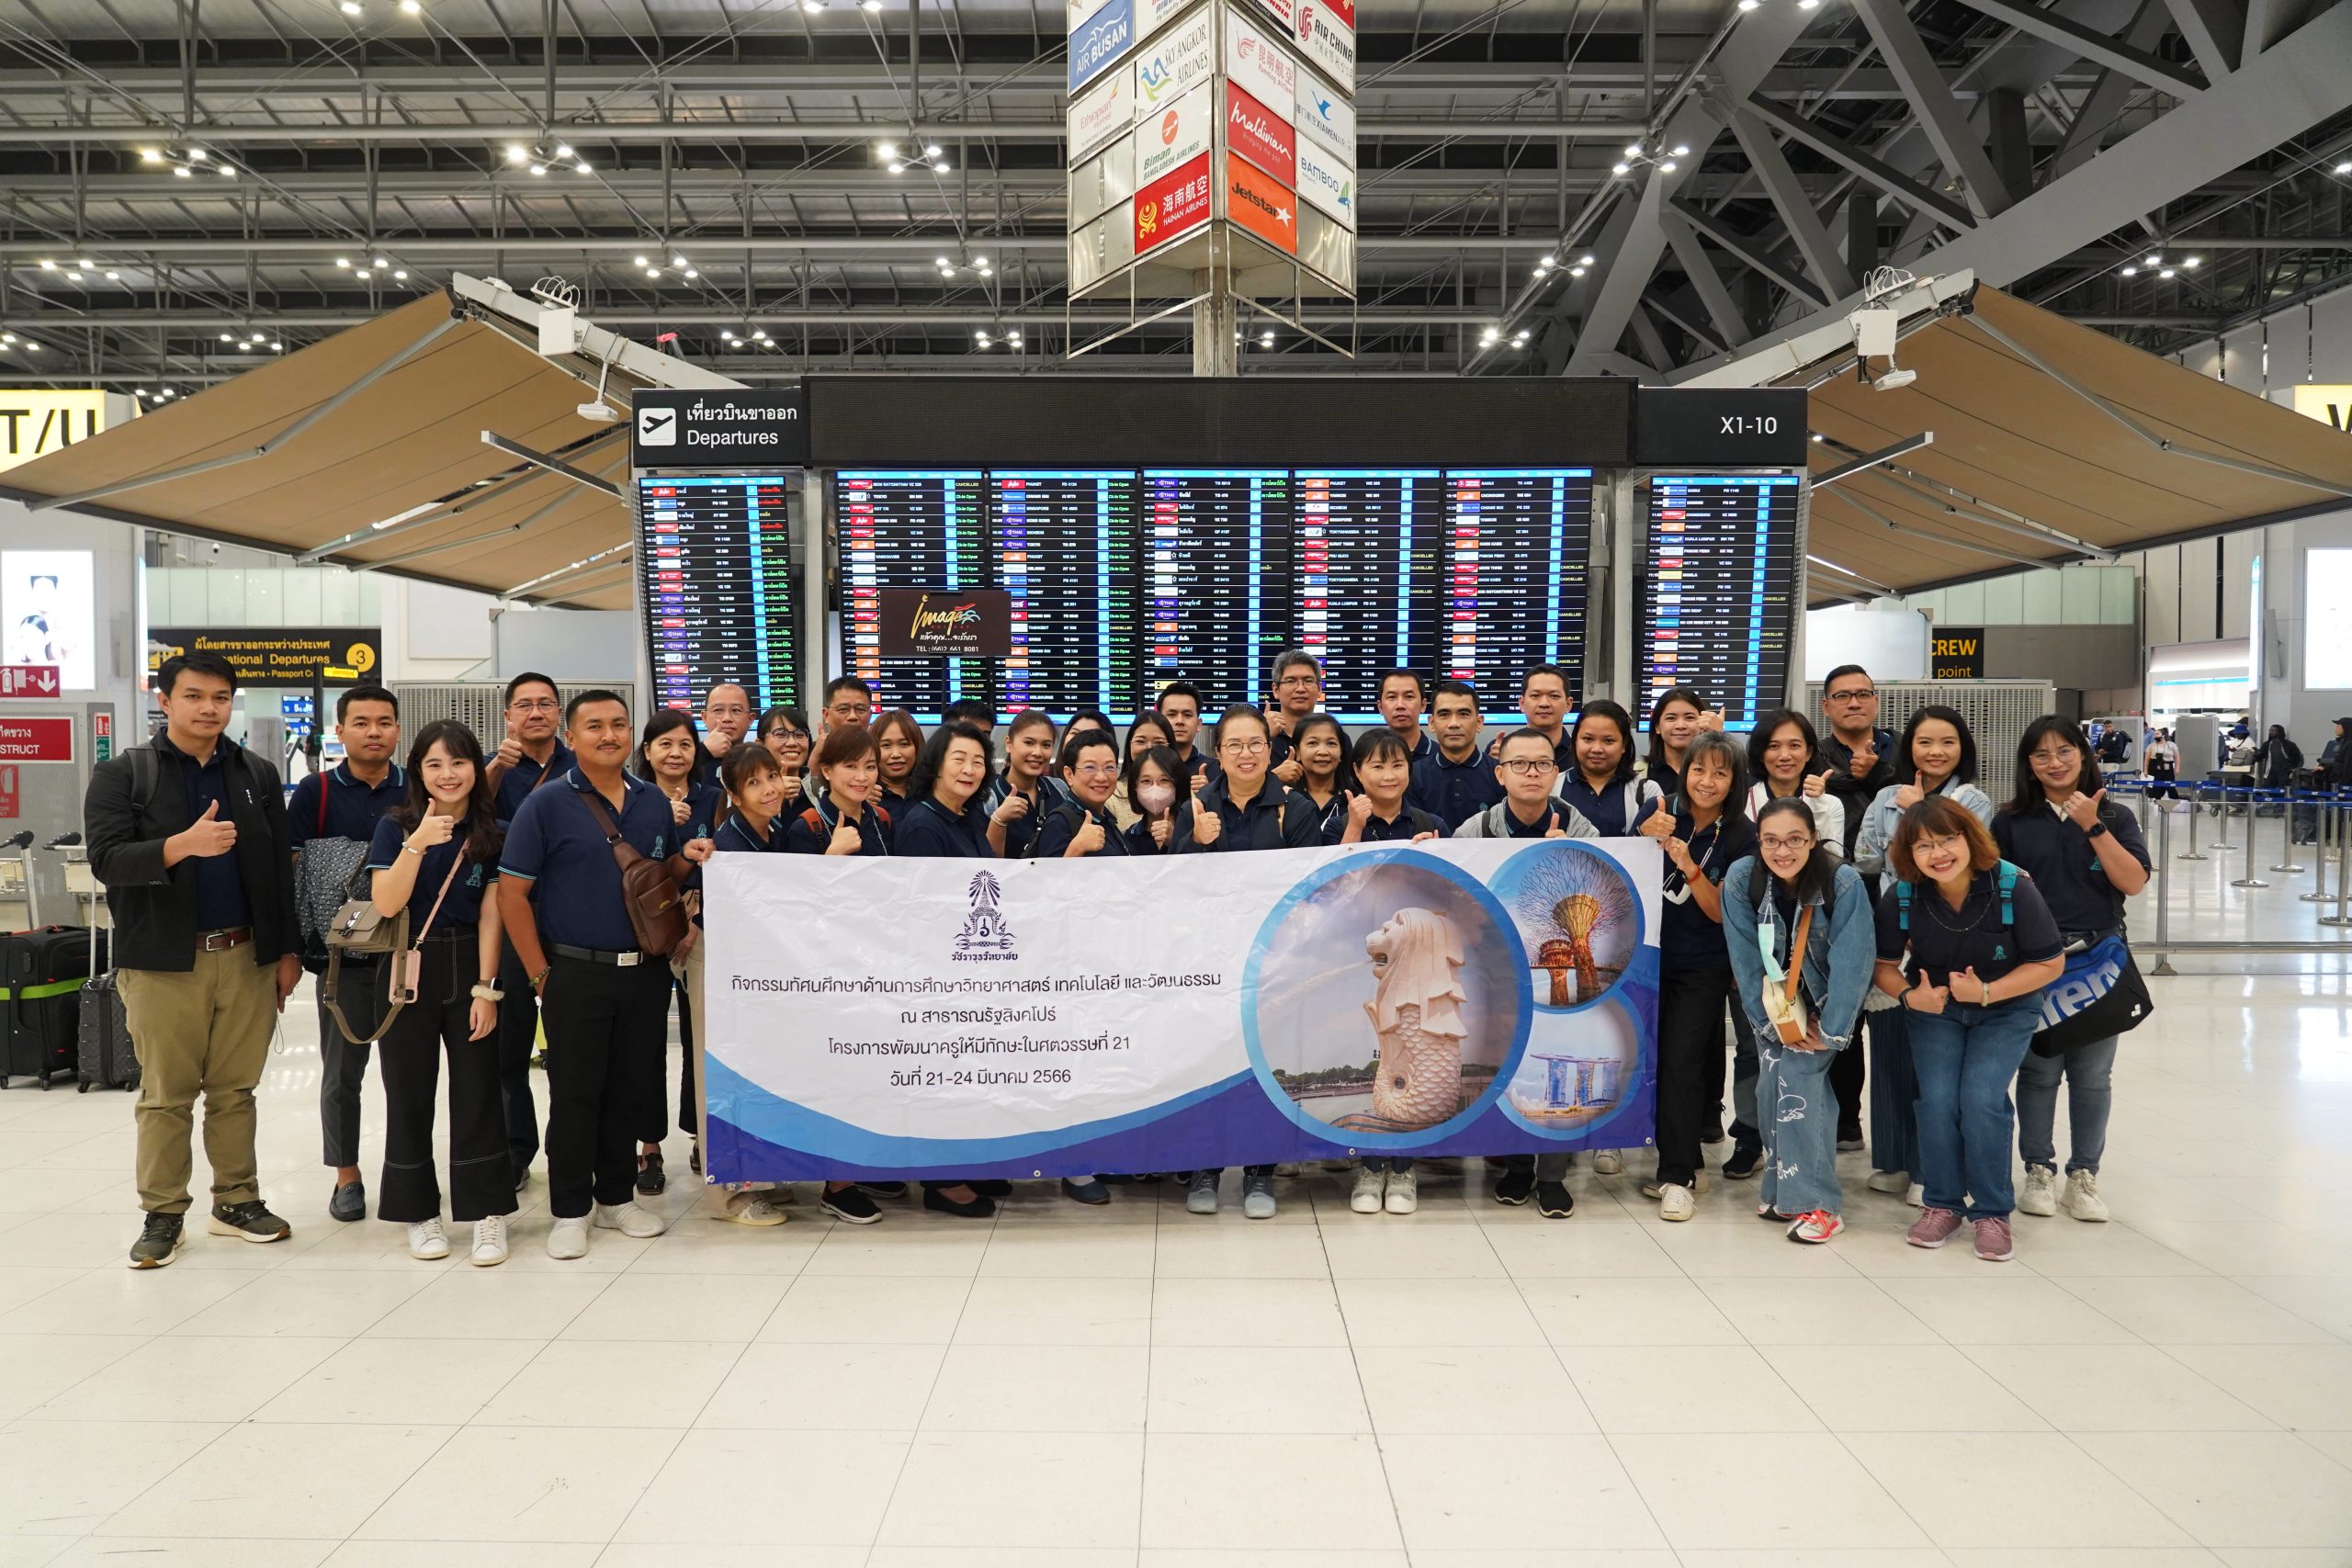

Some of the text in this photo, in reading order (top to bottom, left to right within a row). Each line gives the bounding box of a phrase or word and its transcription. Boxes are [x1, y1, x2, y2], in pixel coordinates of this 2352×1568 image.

[1077, 21, 1127, 76] AIR BUSAN
[1165, 24, 1207, 69] SKY ANGKOR
[1315, 18, 1329, 41] AIR
[1329, 32, 1353, 63] CHINA
[1177, 49, 1208, 86] AIRLINES
[1080, 101, 1112, 130] Ethiopian
[1230, 101, 1293, 161] Maldivian
[1144, 147, 1171, 171] Biman
[1144, 141, 1200, 181] BANGLADESH AIRLINES
[1301, 157, 1339, 193] BAMBOO
[1162, 175, 1207, 215] 海南航空
[1231, 182, 1277, 217] Jetstar
[1163, 197, 1208, 226] HAINAN AIRLINES
[686, 398, 797, 422] เที่ยวบินขาออก
[1720, 416, 1777, 434] X1-10
[686, 430, 779, 448] Departures
[270, 653, 330, 666] Departures
[356, 649, 366, 665] 3
[1929, 639, 1977, 656] CREW
[272, 670, 302, 680] Passport
[1938, 665, 1972, 680] point
[731, 973, 1221, 993] กิจกรรมทัศนศึกษาด้านการศึกษาวิทยาศาสตร์ เทคโนโลยี และวัฒนธรรม
[900, 1006, 1057, 1025] ณ สาธารณรัฐสิงคโปร์
[829, 1031, 1130, 1058] โครงการพัฒนาครูให้มีทักษะในศตวรรษที่ 21
[890, 1066, 1071, 1086] วันที่ 21-24 มีนาคม 2566
